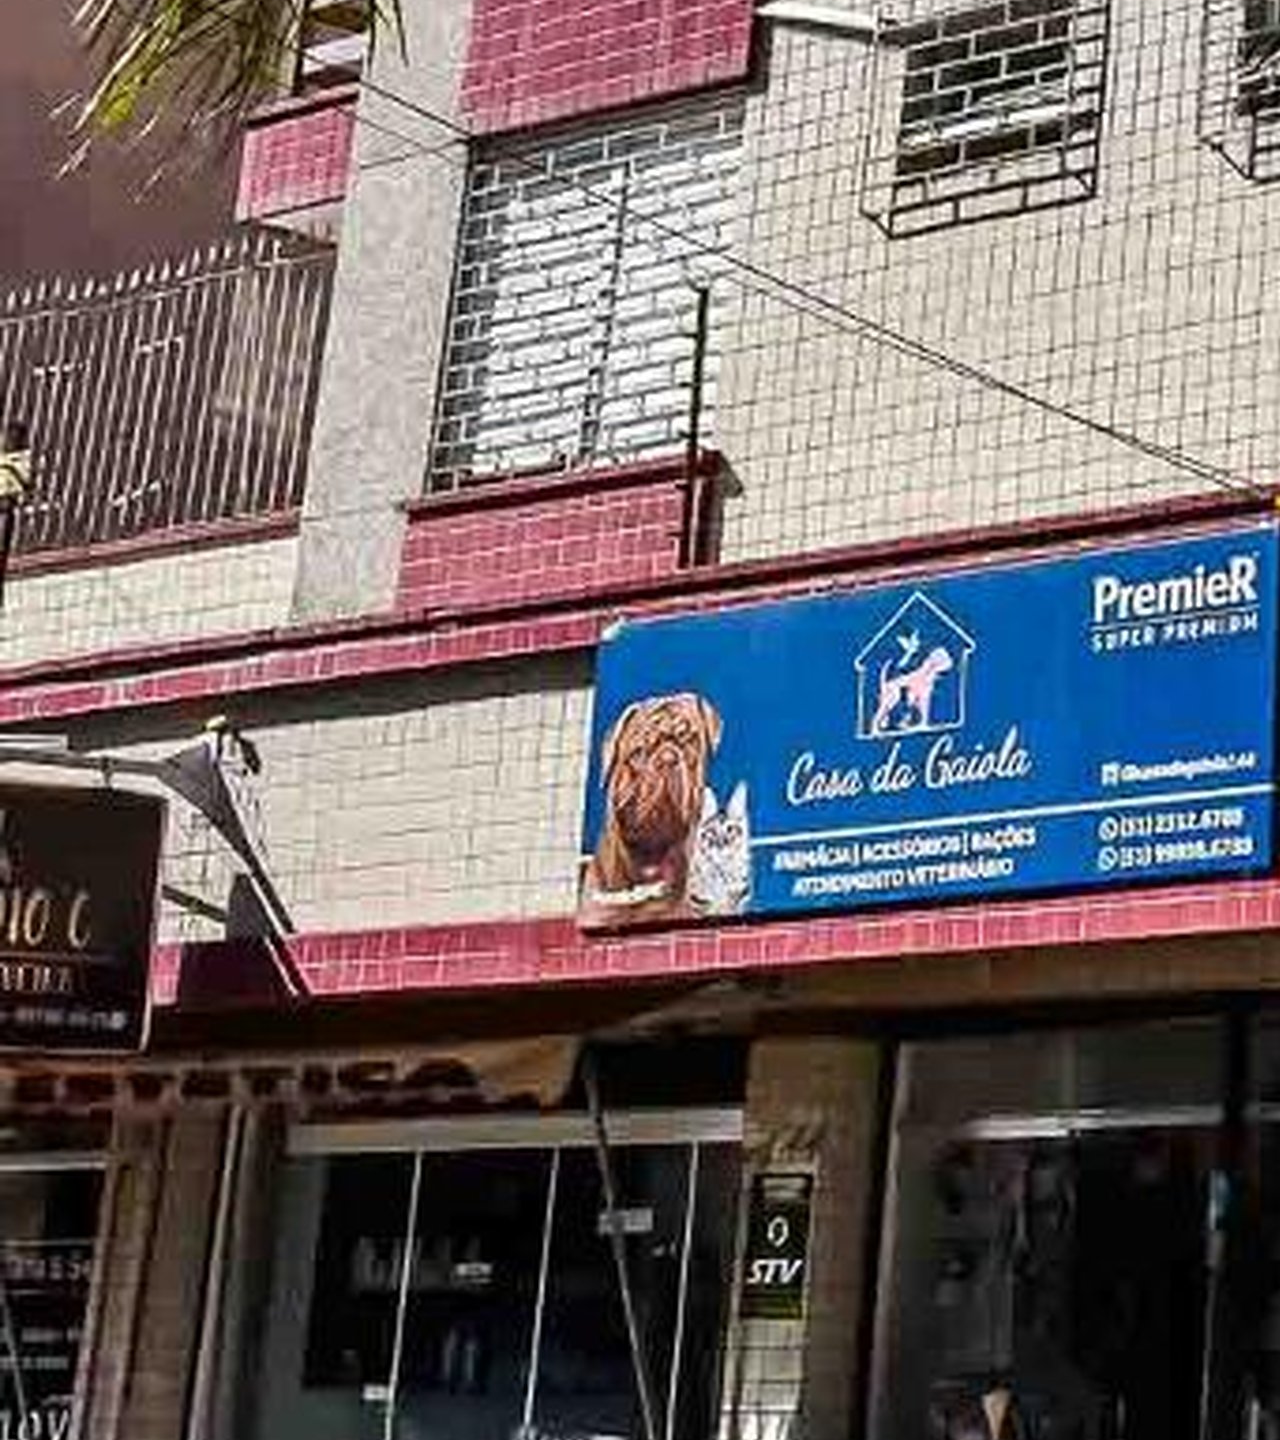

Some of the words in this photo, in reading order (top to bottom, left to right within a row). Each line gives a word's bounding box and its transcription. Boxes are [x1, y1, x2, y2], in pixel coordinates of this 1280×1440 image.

[1093, 555, 1258, 622] PremieR
[1090, 627, 1156, 653] SUPER
[1162, 611, 1258, 641] PREMIUM
[787, 752, 863, 806] Casa
[871, 741, 916, 792] da
[925, 724, 1032, 788] Gaiola
[746, 1258, 803, 1284] STV
